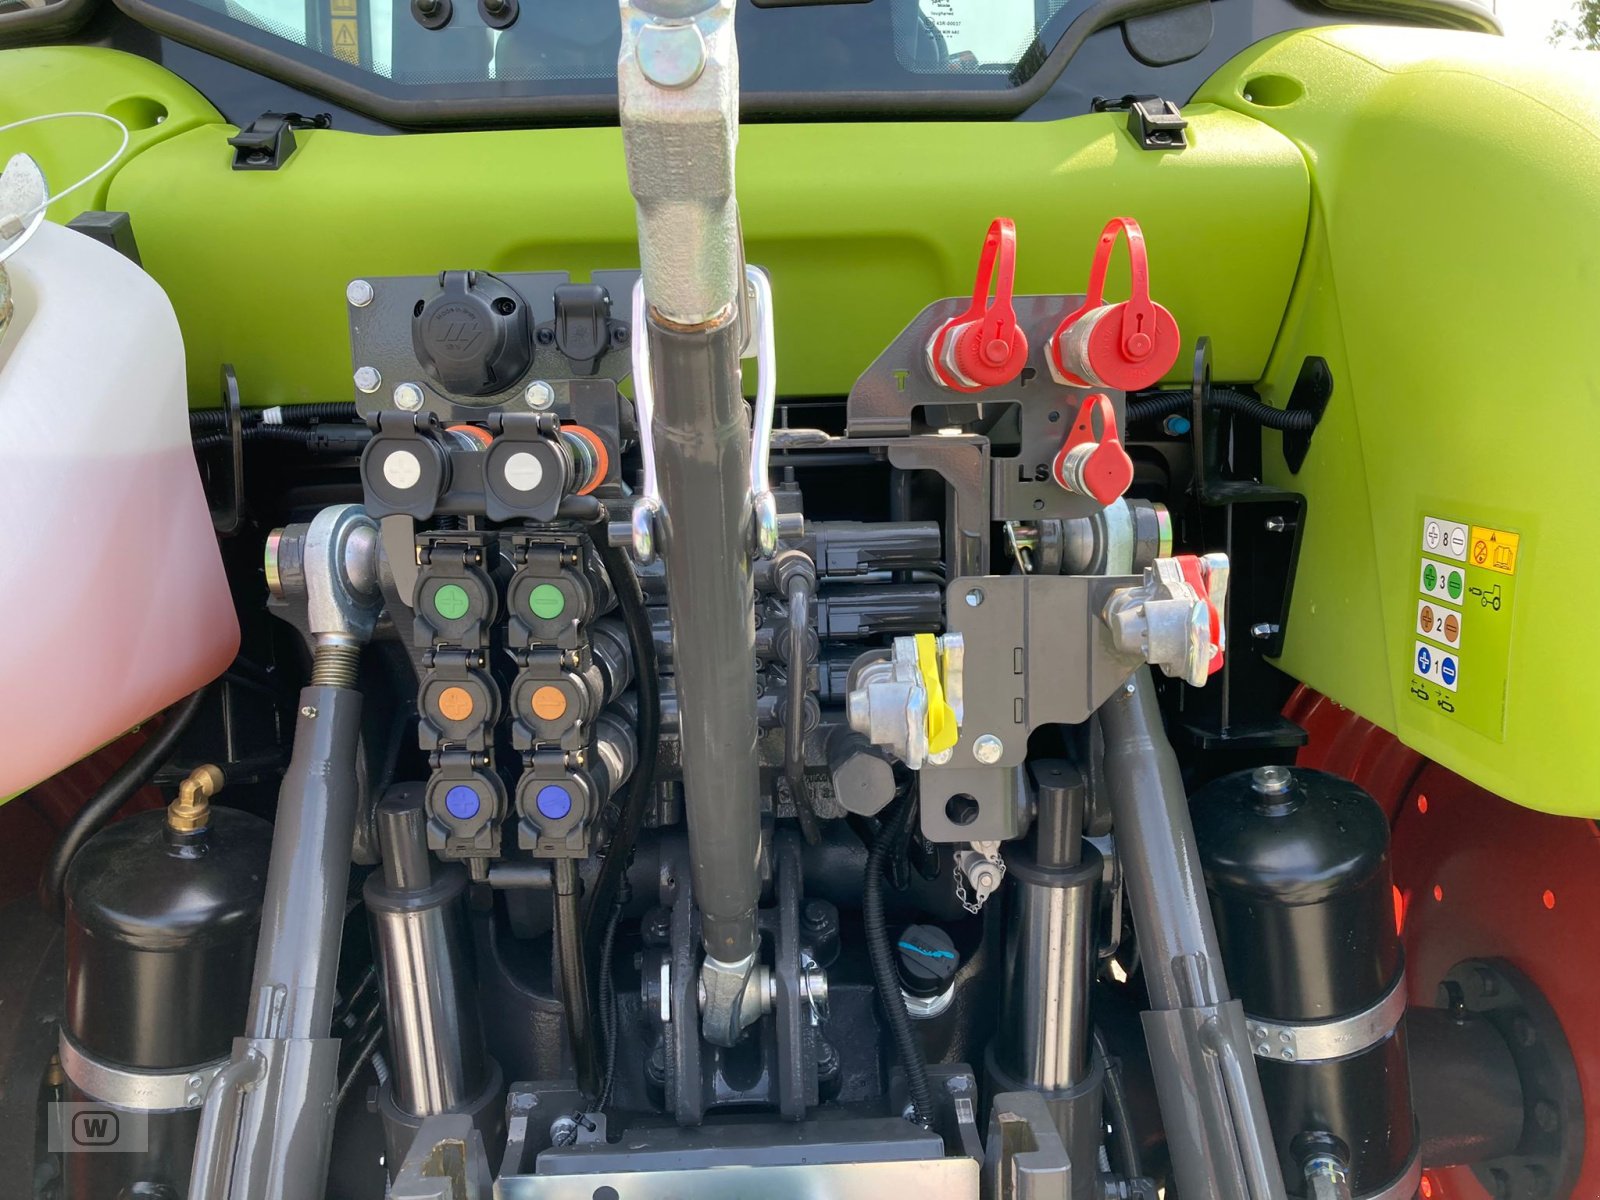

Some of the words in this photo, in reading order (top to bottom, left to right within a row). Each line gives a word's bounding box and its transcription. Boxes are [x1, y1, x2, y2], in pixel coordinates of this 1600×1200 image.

[892, 369, 911, 392] T
[1020, 367, 1037, 387] P
[1018, 464, 1050, 482] LS
[1442, 532, 1449, 546] 8
[1439, 575, 1446, 589] 3
[1436, 618, 1442, 632] 2
[1434, 660, 1439, 674] 1
